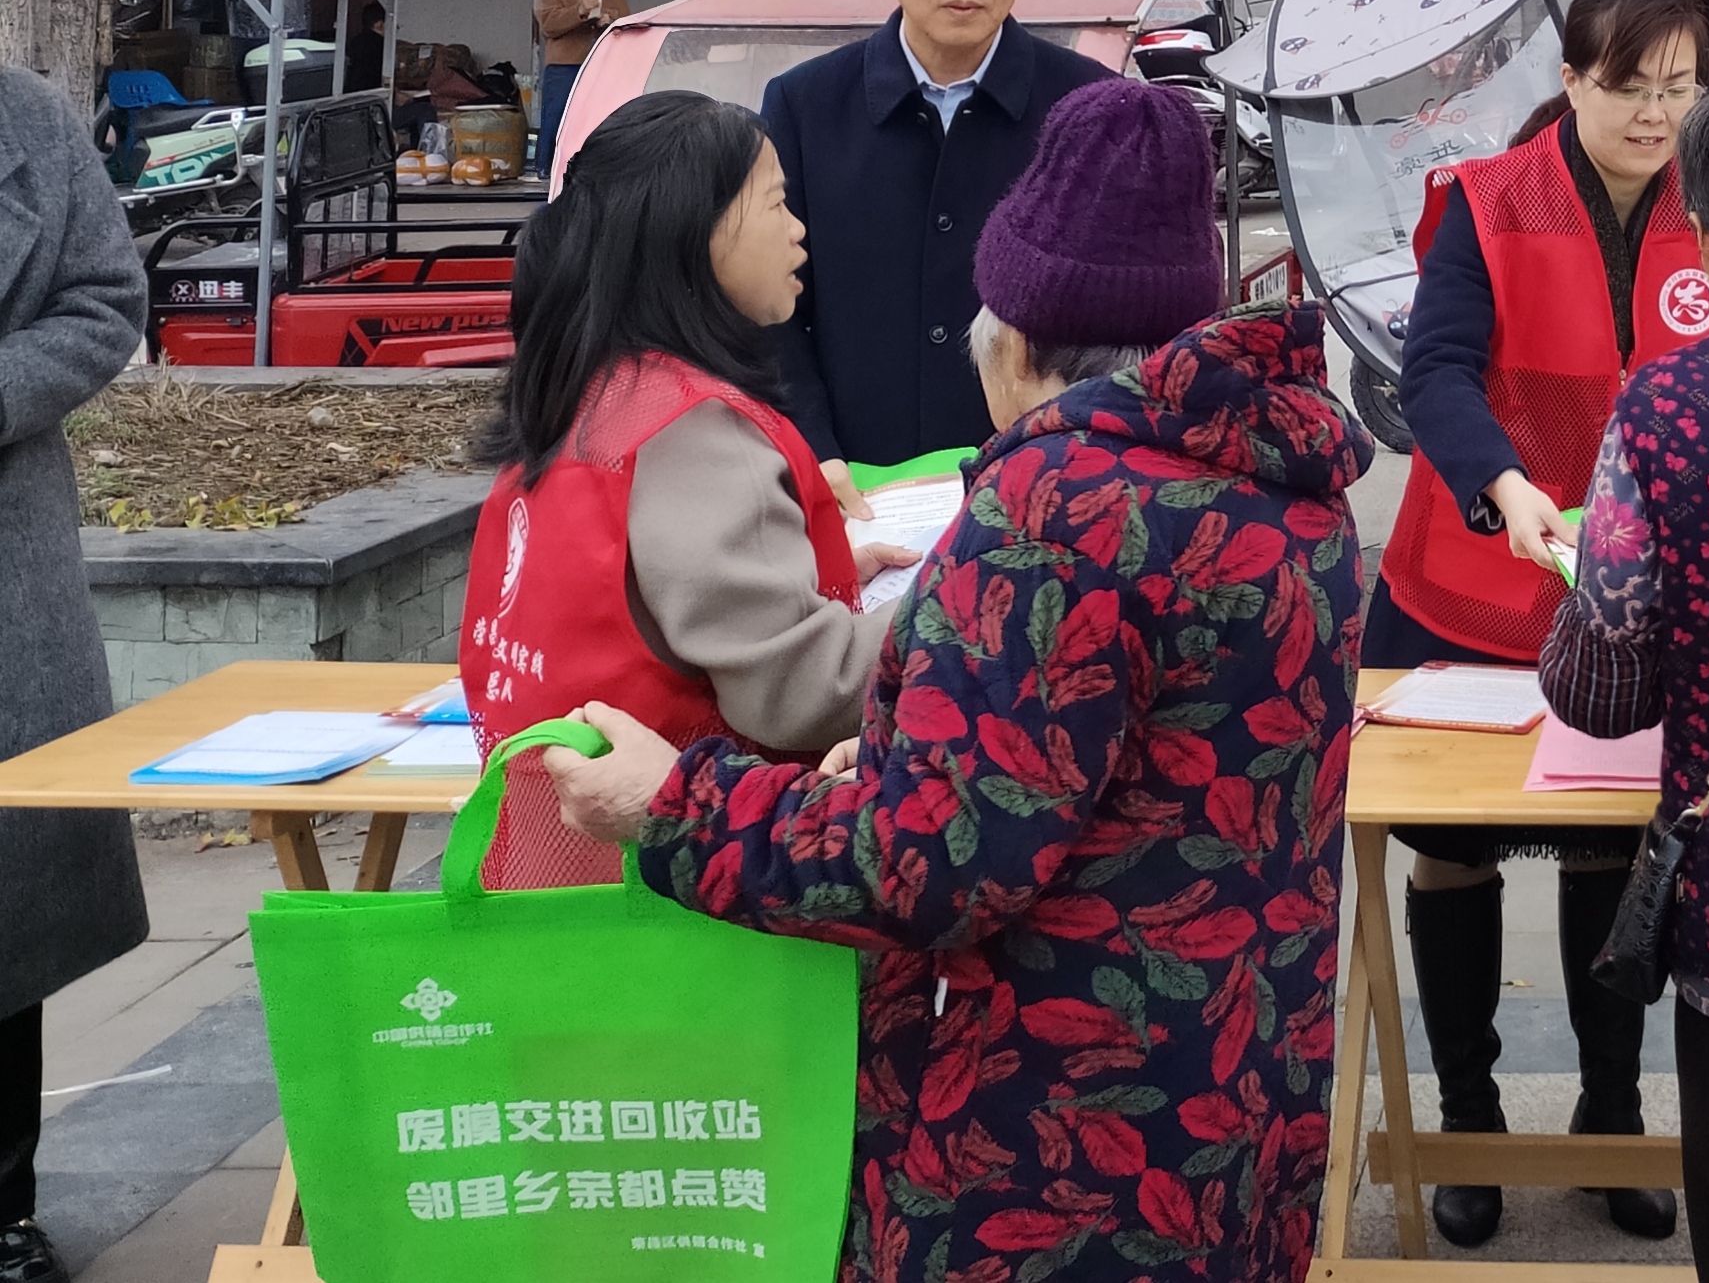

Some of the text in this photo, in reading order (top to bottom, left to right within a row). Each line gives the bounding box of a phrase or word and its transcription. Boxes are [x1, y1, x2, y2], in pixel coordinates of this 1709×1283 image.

[397, 1099, 762, 1154] 废膜交进回收站
[406, 1168, 767, 1221] 邻里乡亲都点赞
